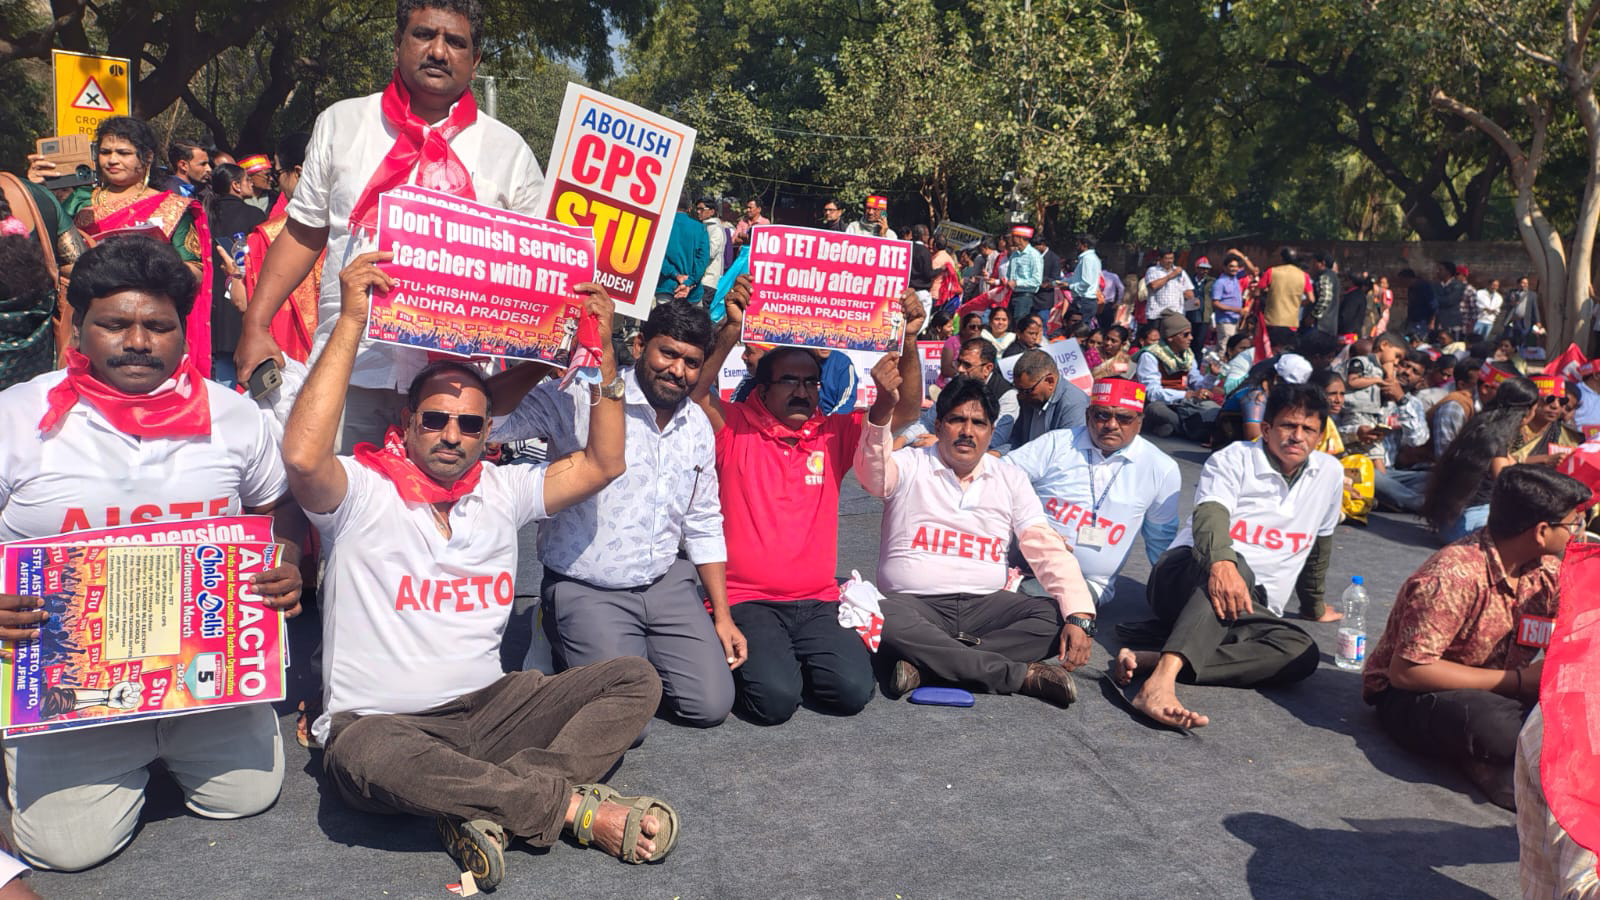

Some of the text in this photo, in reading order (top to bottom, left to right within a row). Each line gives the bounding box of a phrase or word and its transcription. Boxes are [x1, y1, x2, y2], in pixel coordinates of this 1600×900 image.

[581, 108, 671, 158] ABOLISH
[572, 134, 662, 204] CPS
[388, 204, 442, 239] Don't
[446, 220, 516, 255] punish
[519, 237, 588, 268] service
[556, 191, 652, 274] STU
[392, 242, 486, 280] teachers
[490, 260, 532, 290] with
[756, 232, 908, 270] No TET before RTE
[594, 270, 634, 294] RADESH
[754, 261, 905, 298] TET only after RTE
[394, 278, 549, 314] STU-KRISHNA DISTRICT
[394, 292, 466, 316] ANDHRA
[470, 308, 540, 326] PRADESH
[760, 290, 876, 310] STU-KRISHNA DISTRICT
[762, 302, 812, 316] ANDHRA
[814, 307, 870, 322] PRADESH
[911, 526, 1001, 562] AIFETO
[1230, 520, 1312, 553] AIST
[30, 548, 42, 572] STFI,
[94, 563, 102, 576] STU
[228, 554, 236, 567] India
[20, 562, 29, 596] AIFRTE
[32, 574, 41, 596] AIST
[48, 570, 58, 590] STU
[184, 546, 194, 638] Parliament March
[196, 546, 224, 638] Chalo Delhi
[395, 572, 513, 612] AIFETO
[88, 590, 100, 608] STU
[238, 547, 266, 696] AIJACTO
[228, 634, 236, 656] Teachers
[17, 665, 27, 690] JFME
[52, 668, 60, 682] STU
[112, 667, 122, 683] STU
[131, 665, 140, 680] STU
[198, 671, 214, 682] 5
[26, 677, 38, 709] AIFTO,
[148, 678, 168, 706] STU
